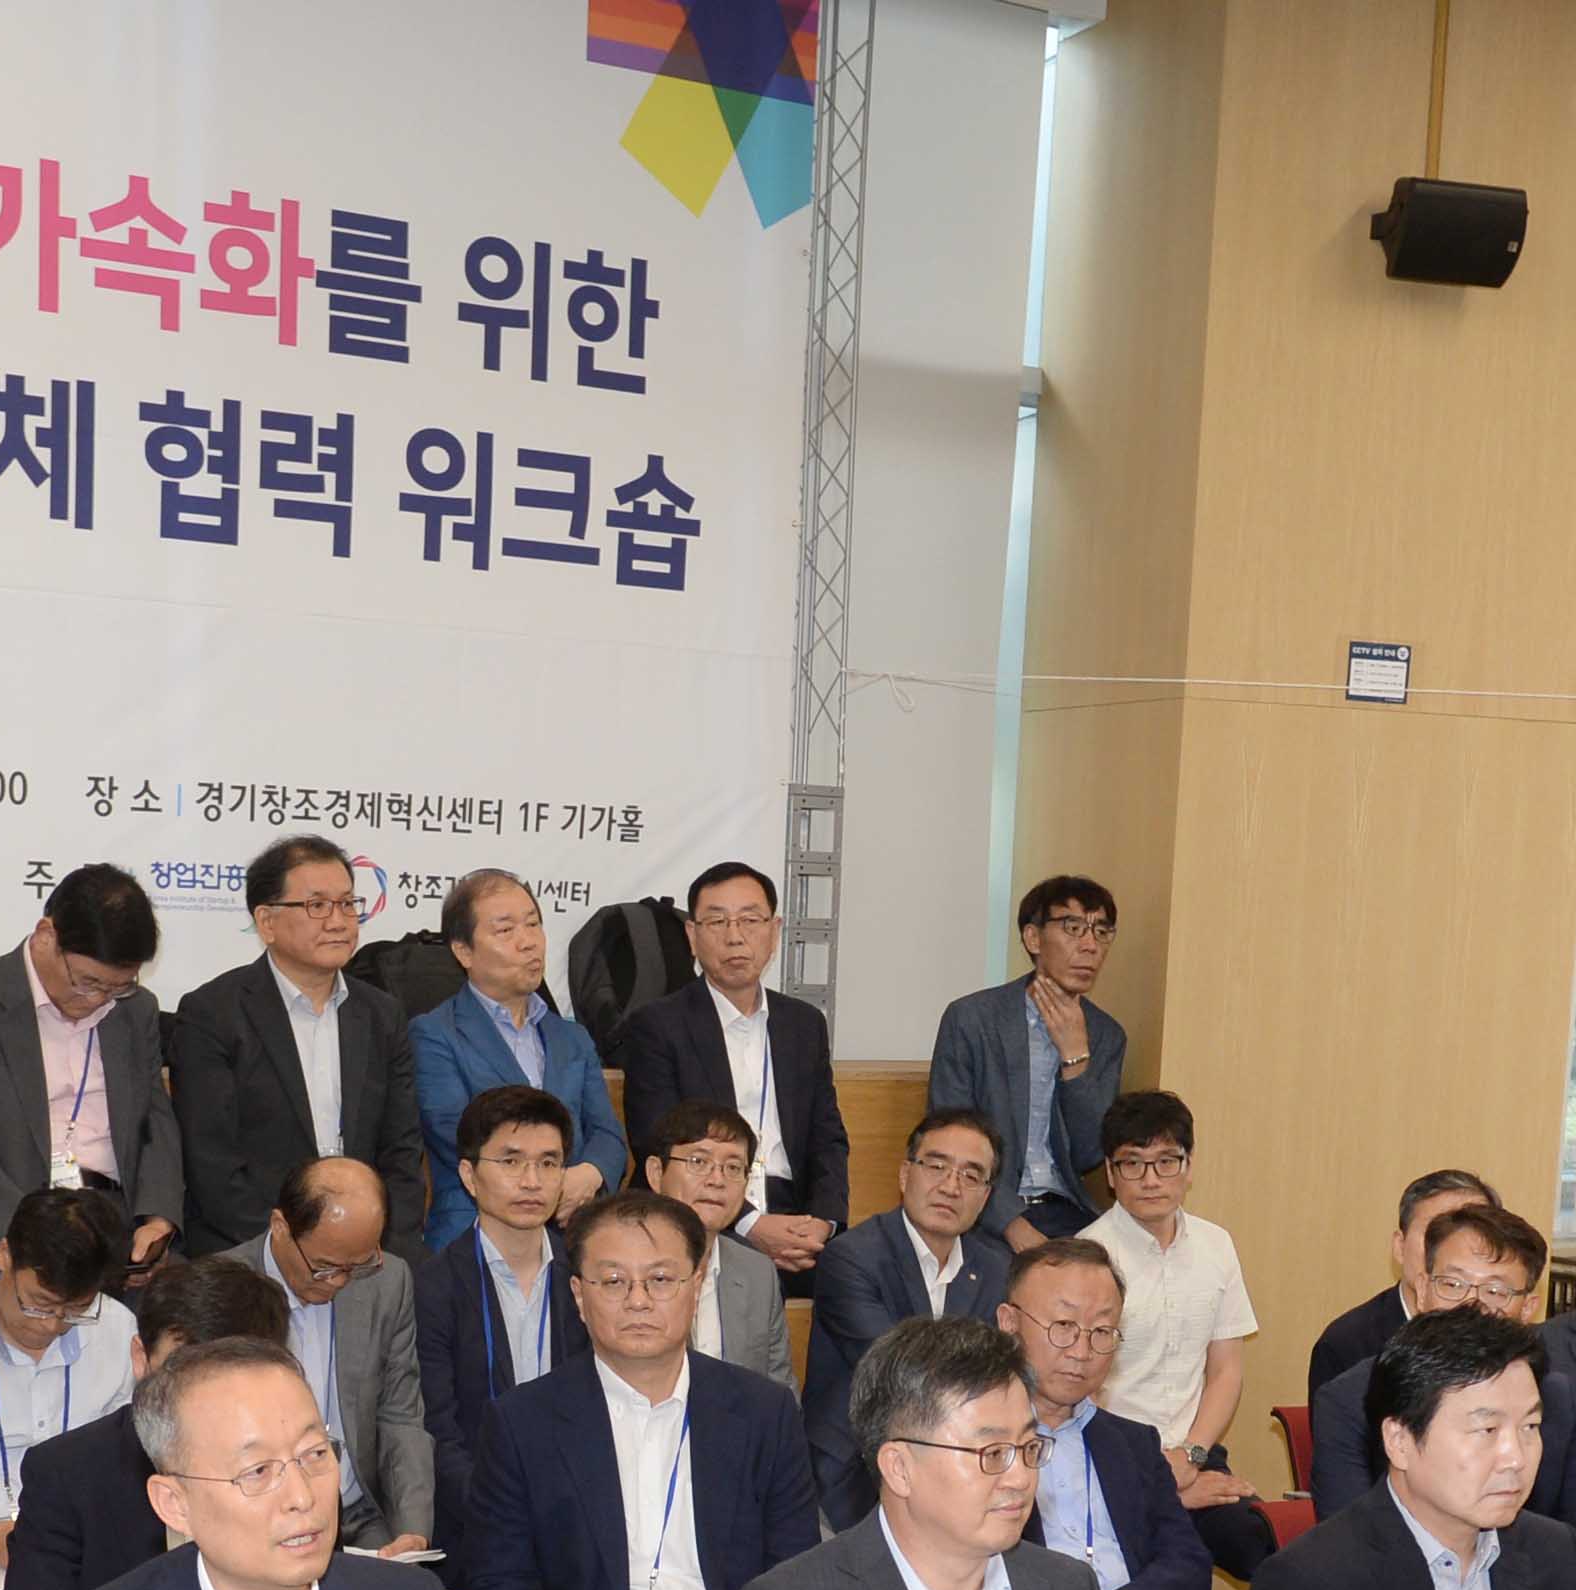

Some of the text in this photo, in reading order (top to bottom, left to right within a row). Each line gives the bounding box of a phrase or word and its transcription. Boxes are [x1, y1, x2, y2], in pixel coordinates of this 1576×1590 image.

[458, 236, 660, 395] 위한
[139, 389, 354, 558] 협력
[399, 428, 701, 591] 워크숍
[1352, 646, 1371, 655] CCTV
[195, 781, 504, 836] 경기창조경제혁신센터
[519, 801, 551, 834] 1F
[561, 802, 645, 843] 기가홀
[149, 860, 249, 892] 창업진흥
[398, 871, 591, 913] 창조센터
